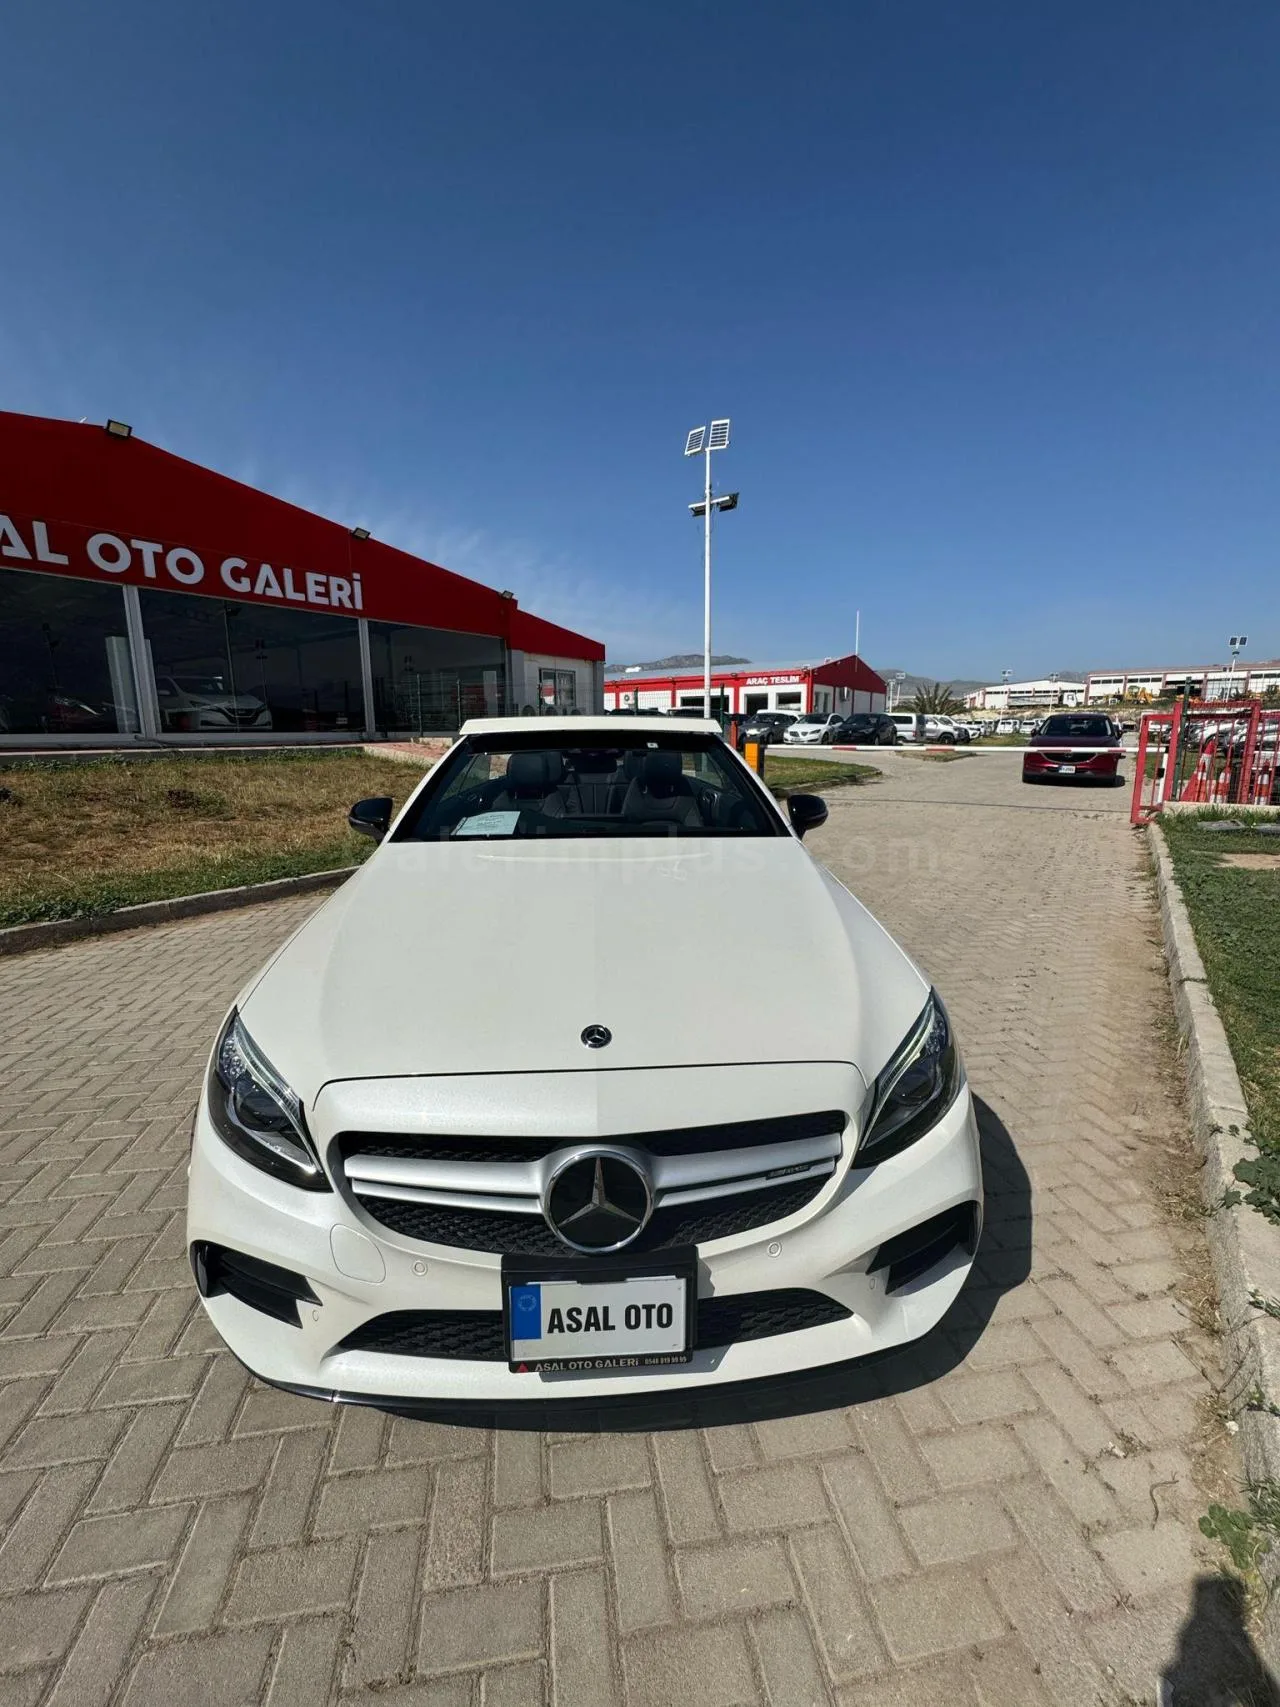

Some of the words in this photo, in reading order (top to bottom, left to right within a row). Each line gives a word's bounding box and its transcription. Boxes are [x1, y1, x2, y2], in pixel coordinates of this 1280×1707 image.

[86, 532, 205, 585] OTO
[547, 1306, 615, 1334] ASAL
[624, 1303, 673, 1330] OTO
[534, 1362, 566, 1372] ASAL
[568, 1360, 593, 1370] OTO
